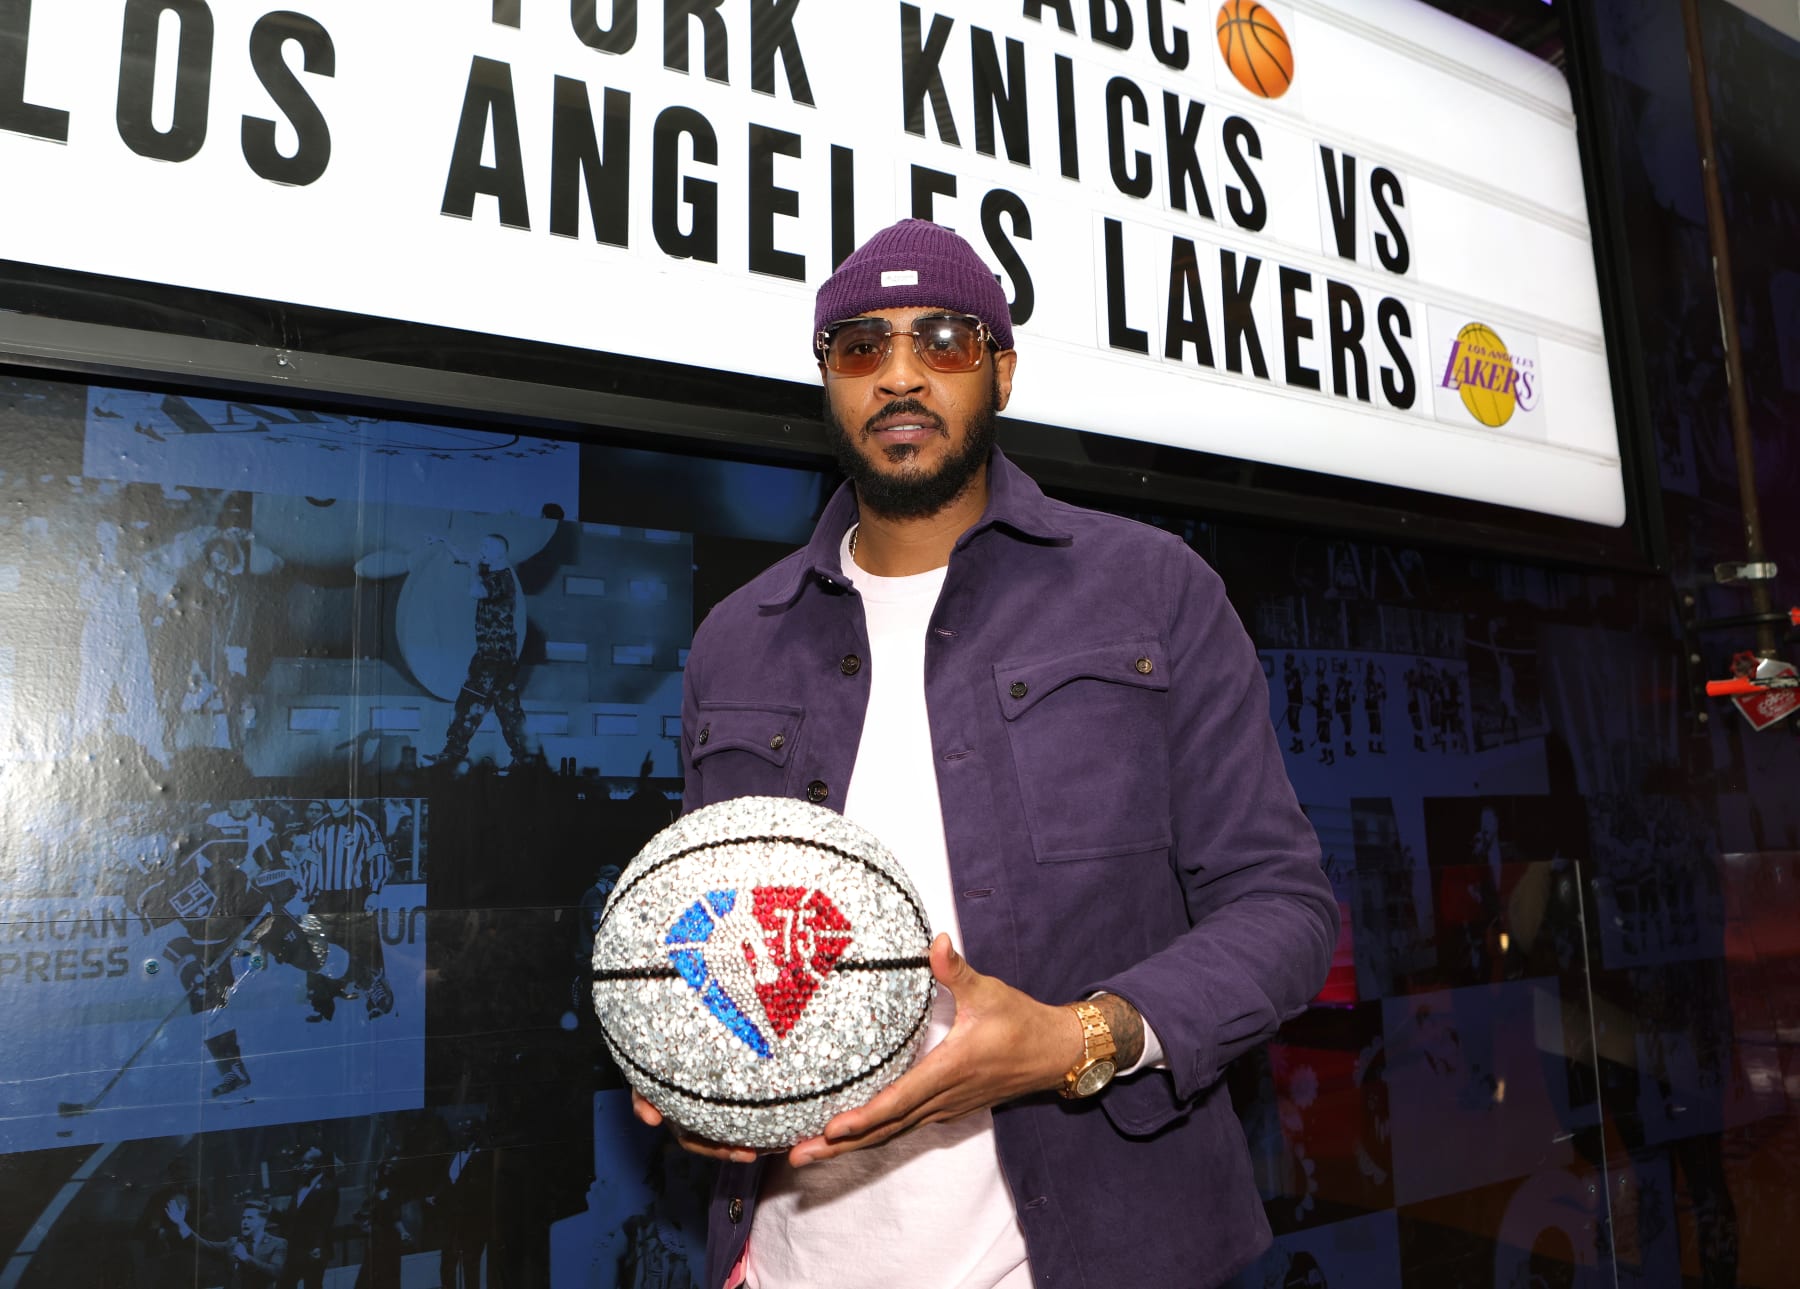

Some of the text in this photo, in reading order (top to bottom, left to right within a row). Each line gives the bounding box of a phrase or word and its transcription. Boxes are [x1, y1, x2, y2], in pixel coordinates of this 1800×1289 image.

[0, 0, 336, 187] LOS
[1104, 217, 1416, 410] LAKERS
[900, 2, 1267, 233] KNICKS
[1319, 146, 1410, 275] VS
[1438, 339, 1541, 412] LAKERS
[1468, 344, 1534, 367] LOS ANGELES
